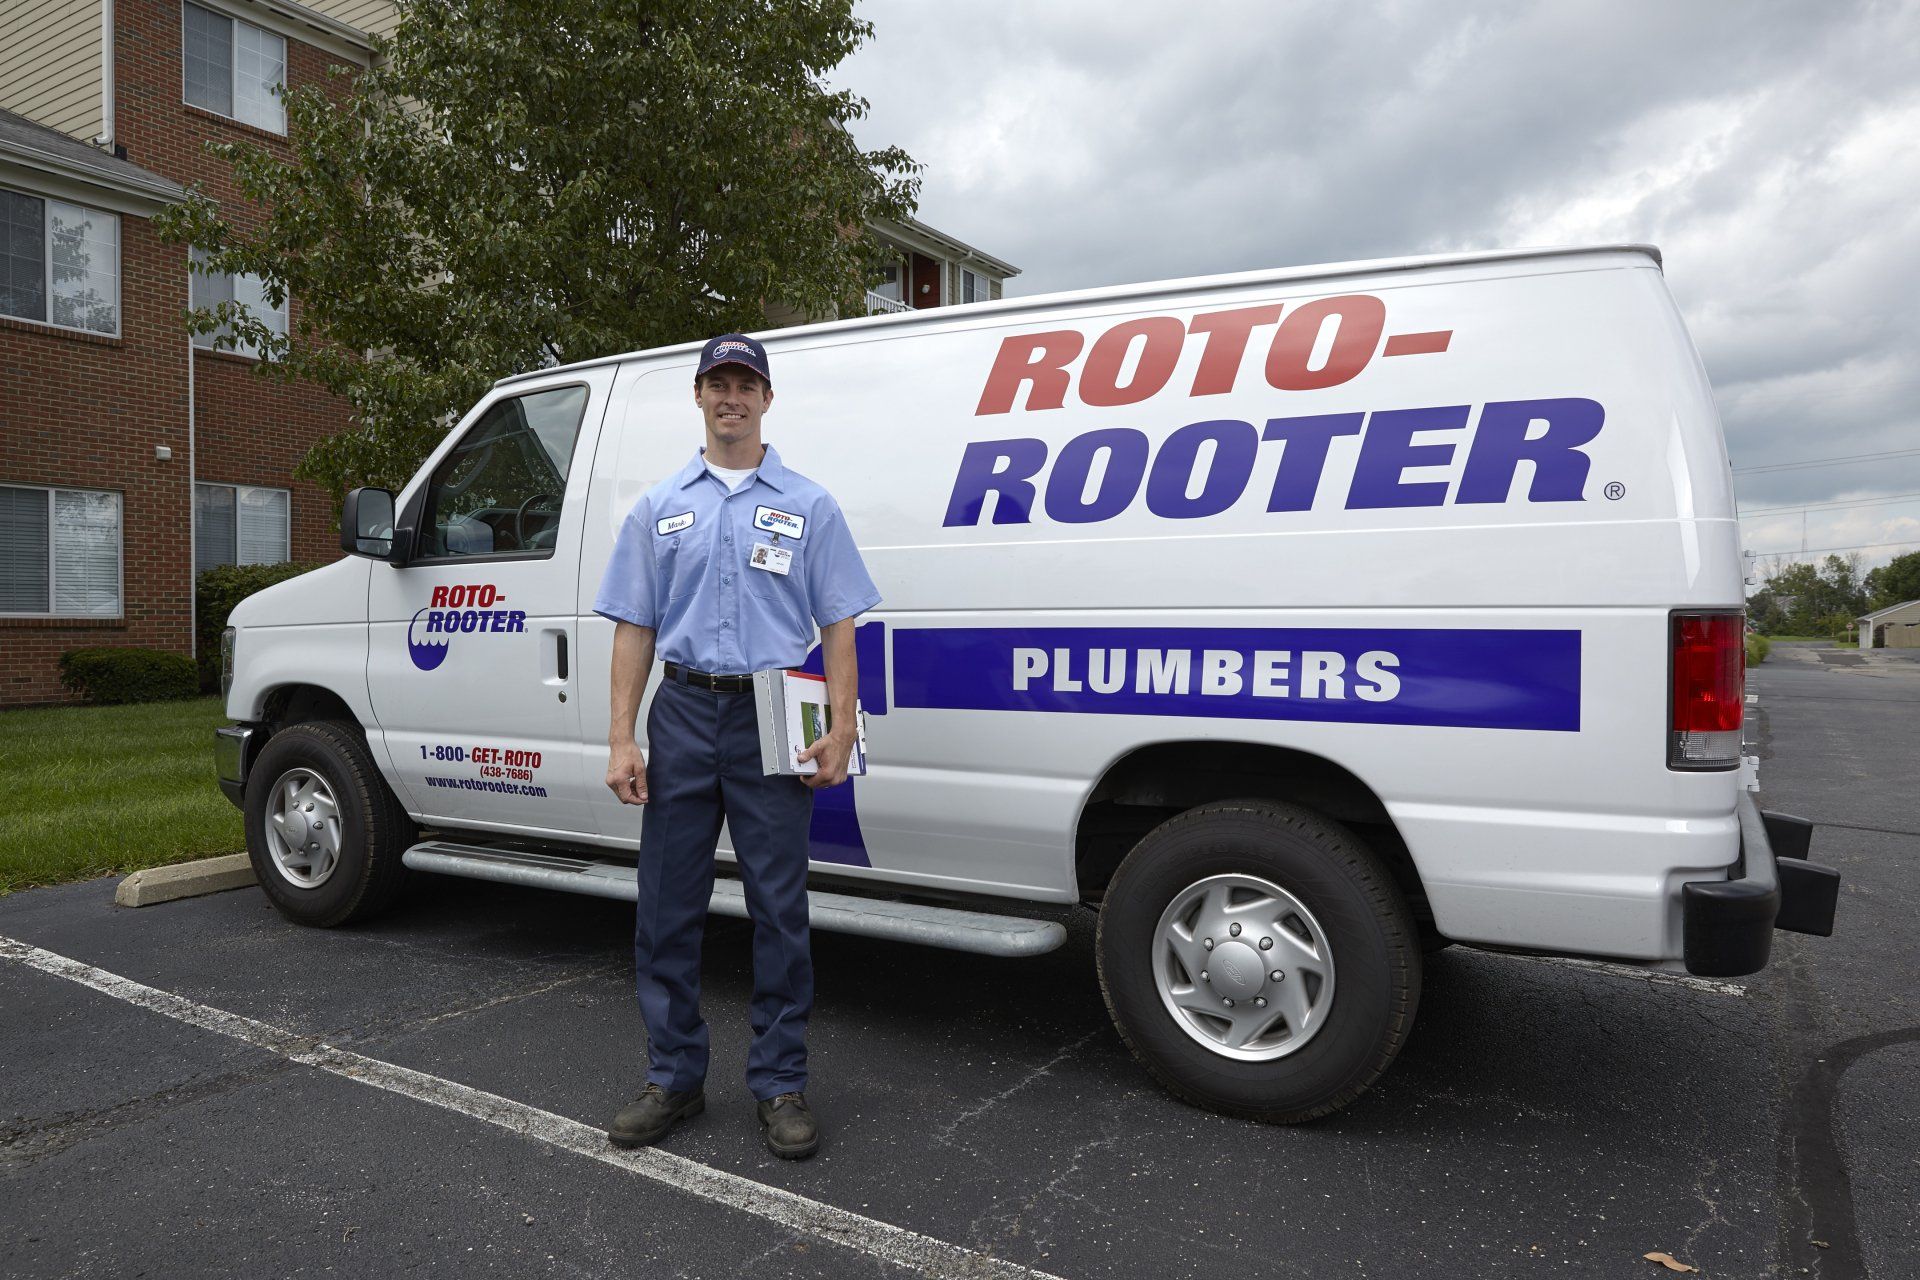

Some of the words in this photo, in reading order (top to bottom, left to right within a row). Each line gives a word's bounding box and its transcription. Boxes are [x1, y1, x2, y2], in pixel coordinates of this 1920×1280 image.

[975, 295, 1453, 416] ROTO-
[942, 397, 1606, 527] ROOTER
[430, 584, 506, 608] ROTO-
[426, 610, 527, 633] ROOTER
[1013, 647, 1401, 702] PLUMBERS
[420, 745, 542, 769] 1-800-GET-ROTO
[480, 765, 533, 783] (438-7686)
[425, 776, 548, 798] www.rotorooter.com
